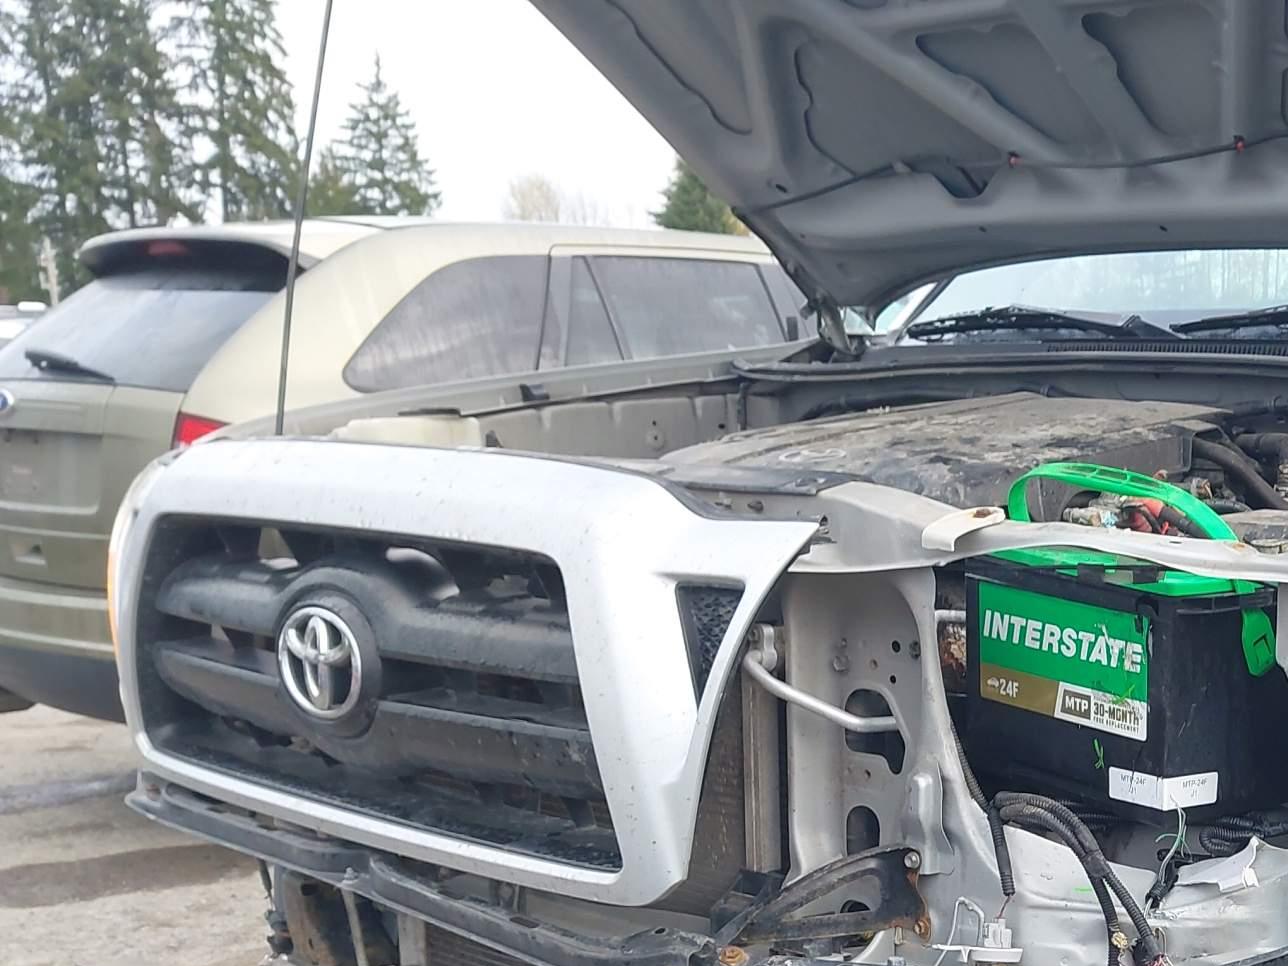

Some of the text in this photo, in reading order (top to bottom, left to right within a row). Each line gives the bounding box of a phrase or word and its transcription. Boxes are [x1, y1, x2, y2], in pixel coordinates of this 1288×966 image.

[983, 609, 1143, 674] INTERSTATE
[999, 677, 1019, 698] 24F
[1065, 695, 1089, 713] MTP
[1093, 701, 1140, 726] 30-MONTH
[1182, 778, 1207, 789] MTP-24F
